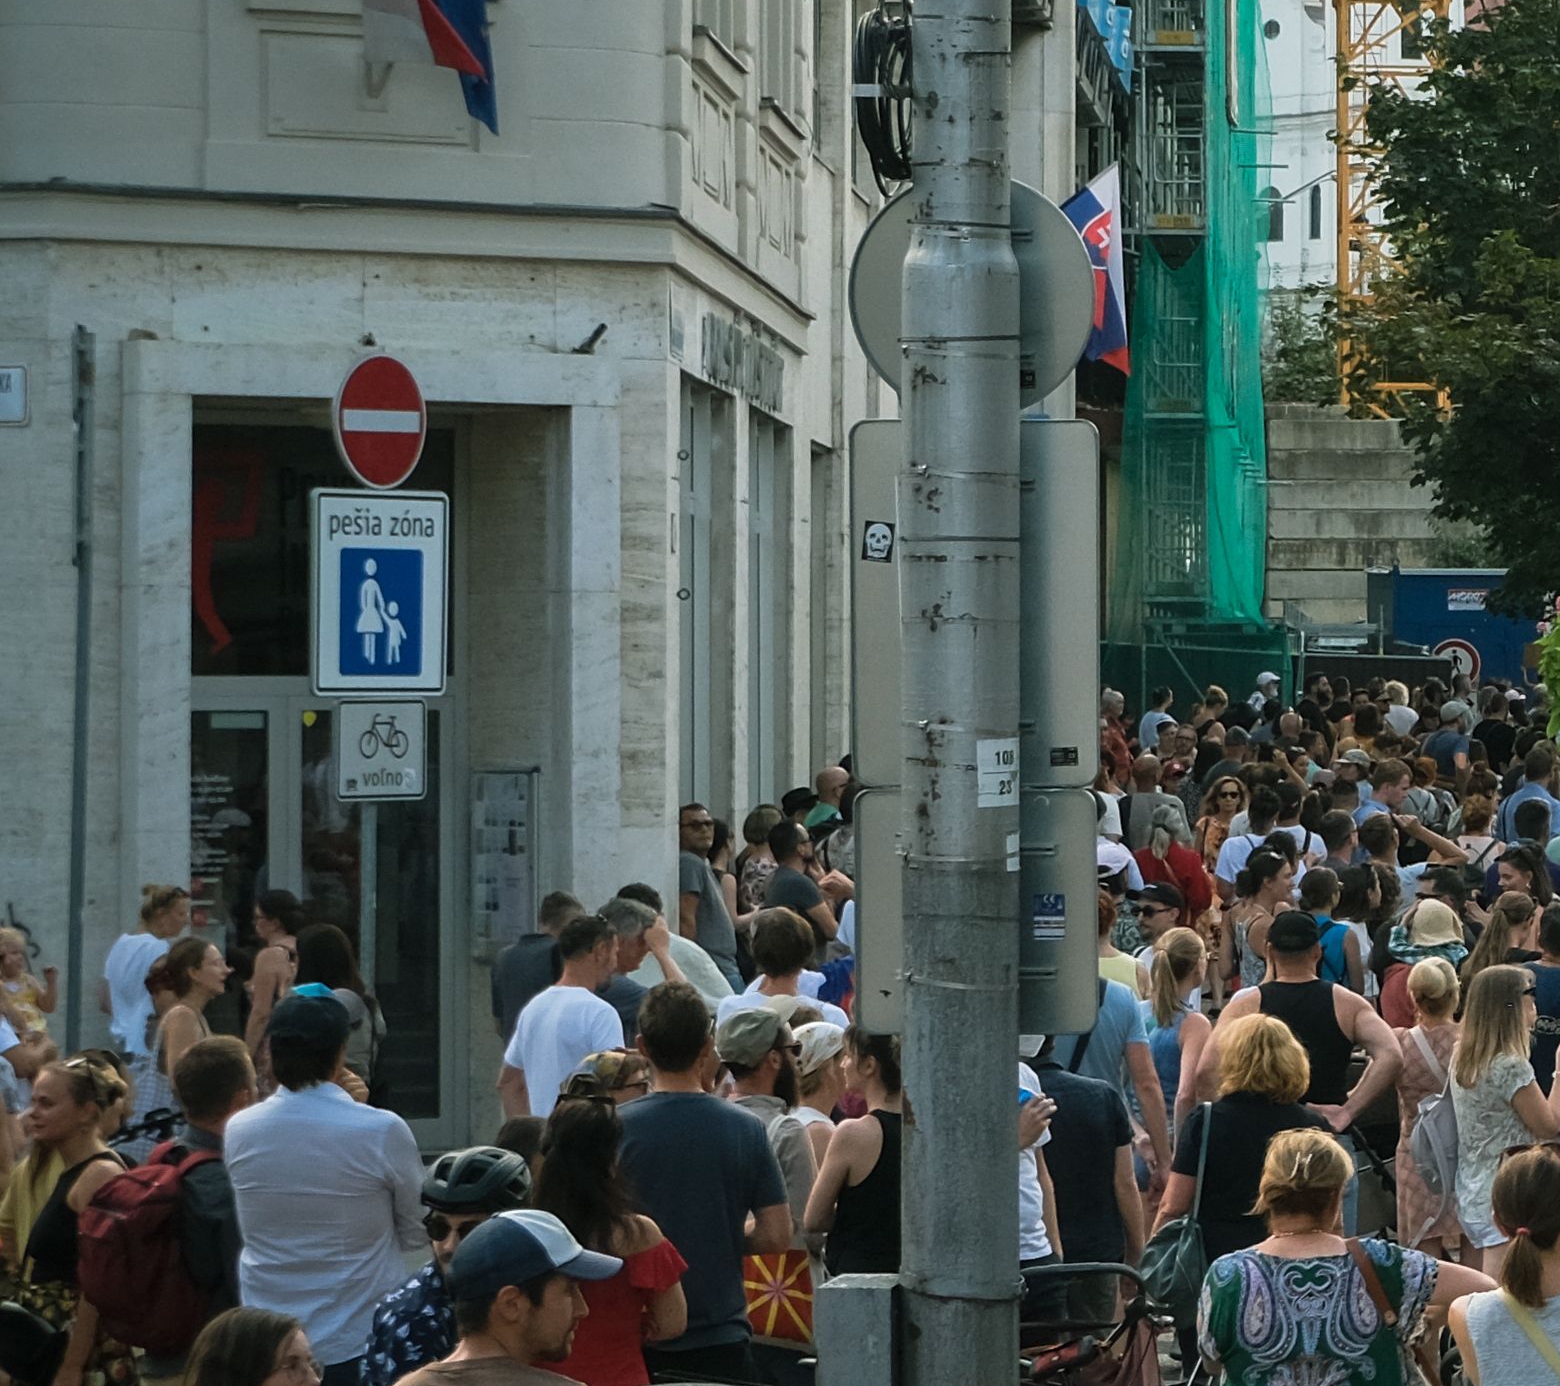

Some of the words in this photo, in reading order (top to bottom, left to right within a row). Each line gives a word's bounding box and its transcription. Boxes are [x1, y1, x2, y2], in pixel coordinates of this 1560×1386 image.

[329, 508, 382, 540] pešia
[389, 510, 435, 538] zóna
[362, 767, 403, 787] voľno
